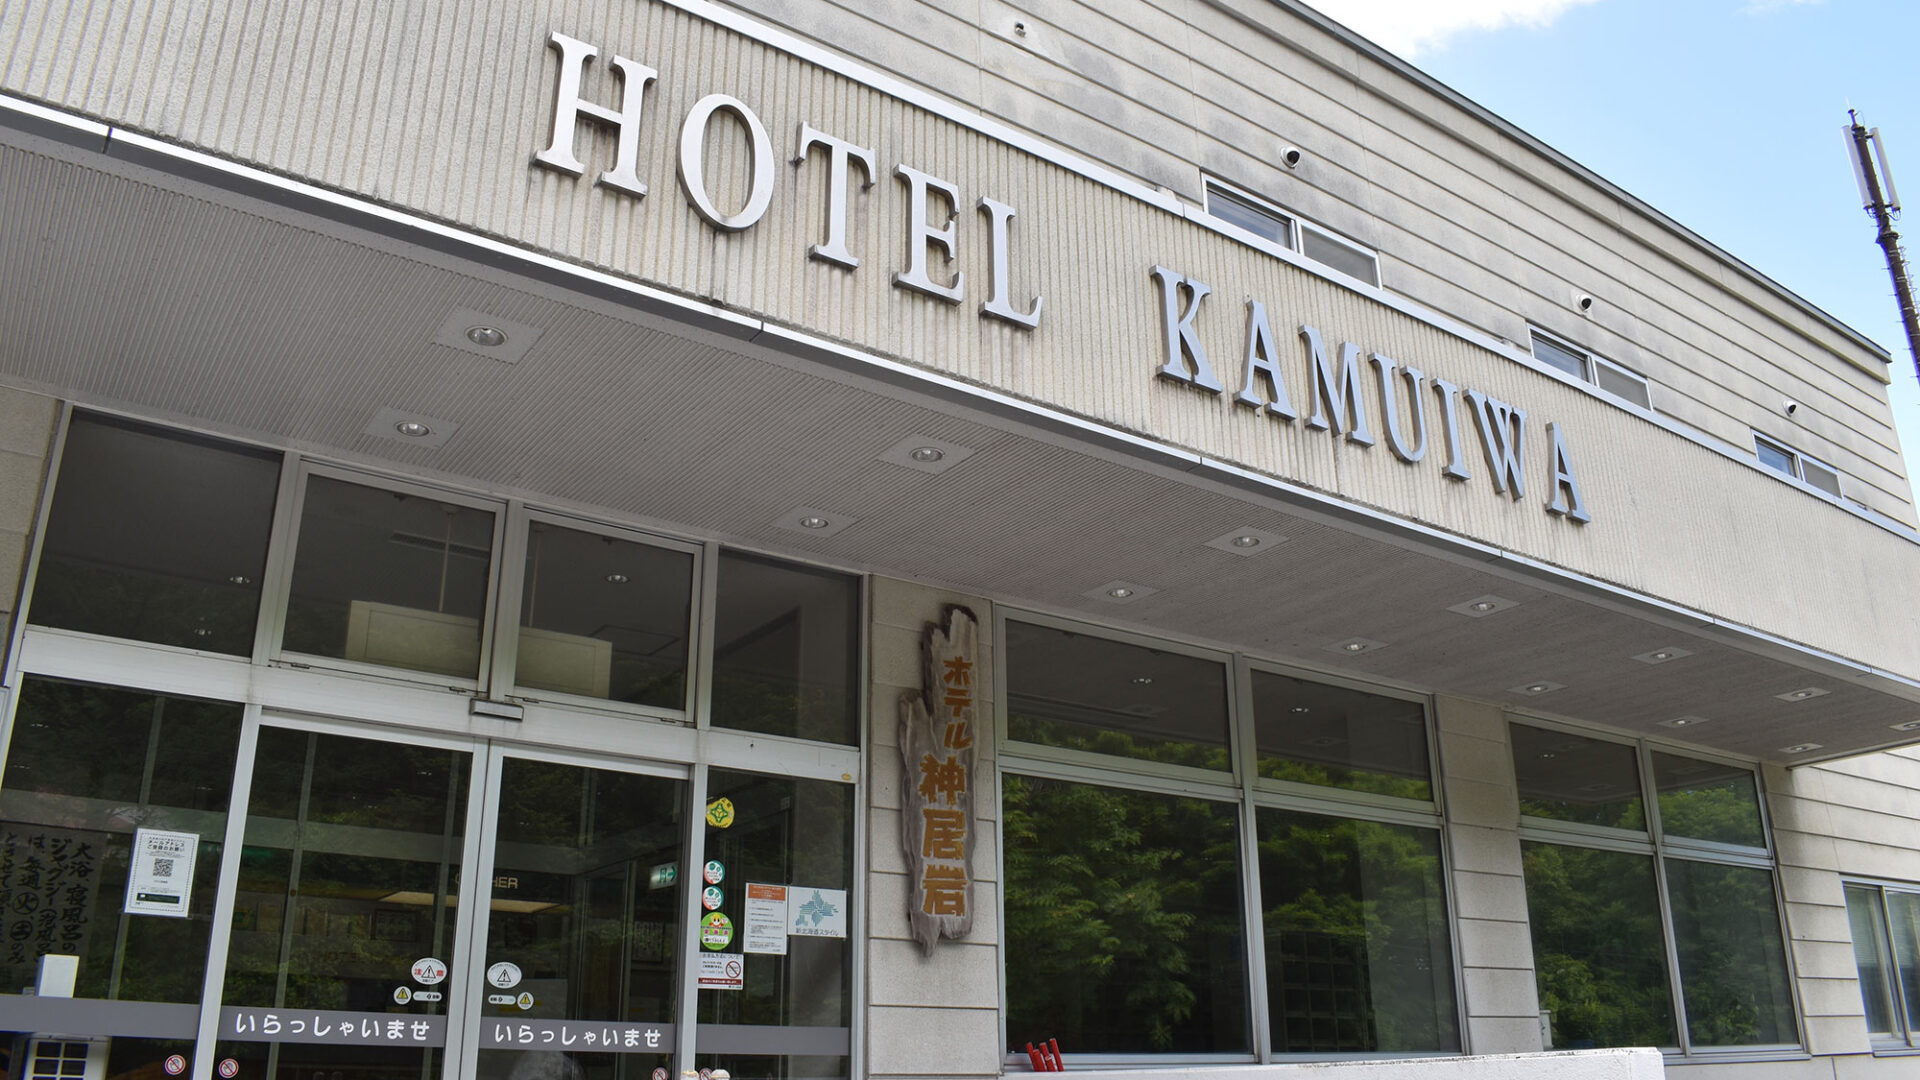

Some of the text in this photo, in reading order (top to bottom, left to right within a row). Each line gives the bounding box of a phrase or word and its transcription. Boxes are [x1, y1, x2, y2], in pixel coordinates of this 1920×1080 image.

[532, 31, 1591, 524] HOTEL KAMUIWA
[235, 1012, 430, 1041] いらっしゃいませ
[494, 1023, 662, 1048] いらっしゃいませ
